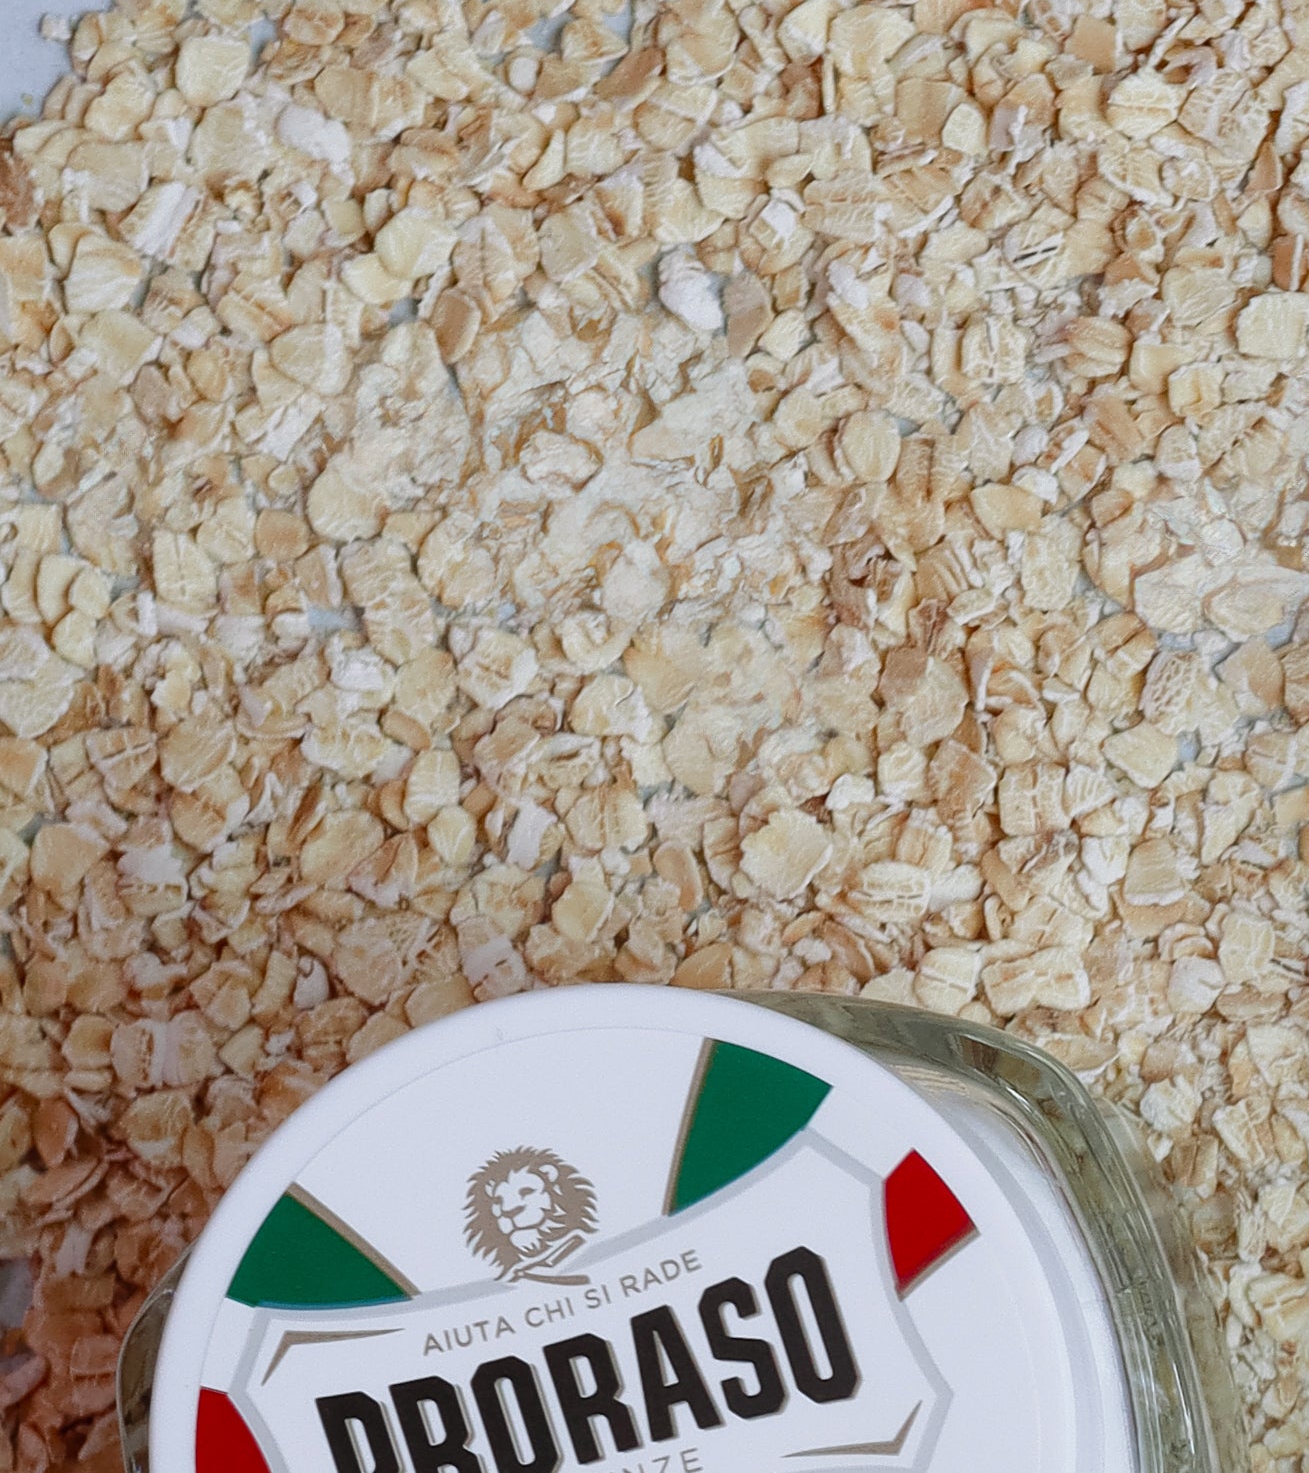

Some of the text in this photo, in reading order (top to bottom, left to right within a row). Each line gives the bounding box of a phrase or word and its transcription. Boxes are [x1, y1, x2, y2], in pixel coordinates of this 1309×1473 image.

[423, 1249, 702, 1357] AIUTA CHI SI RADE
